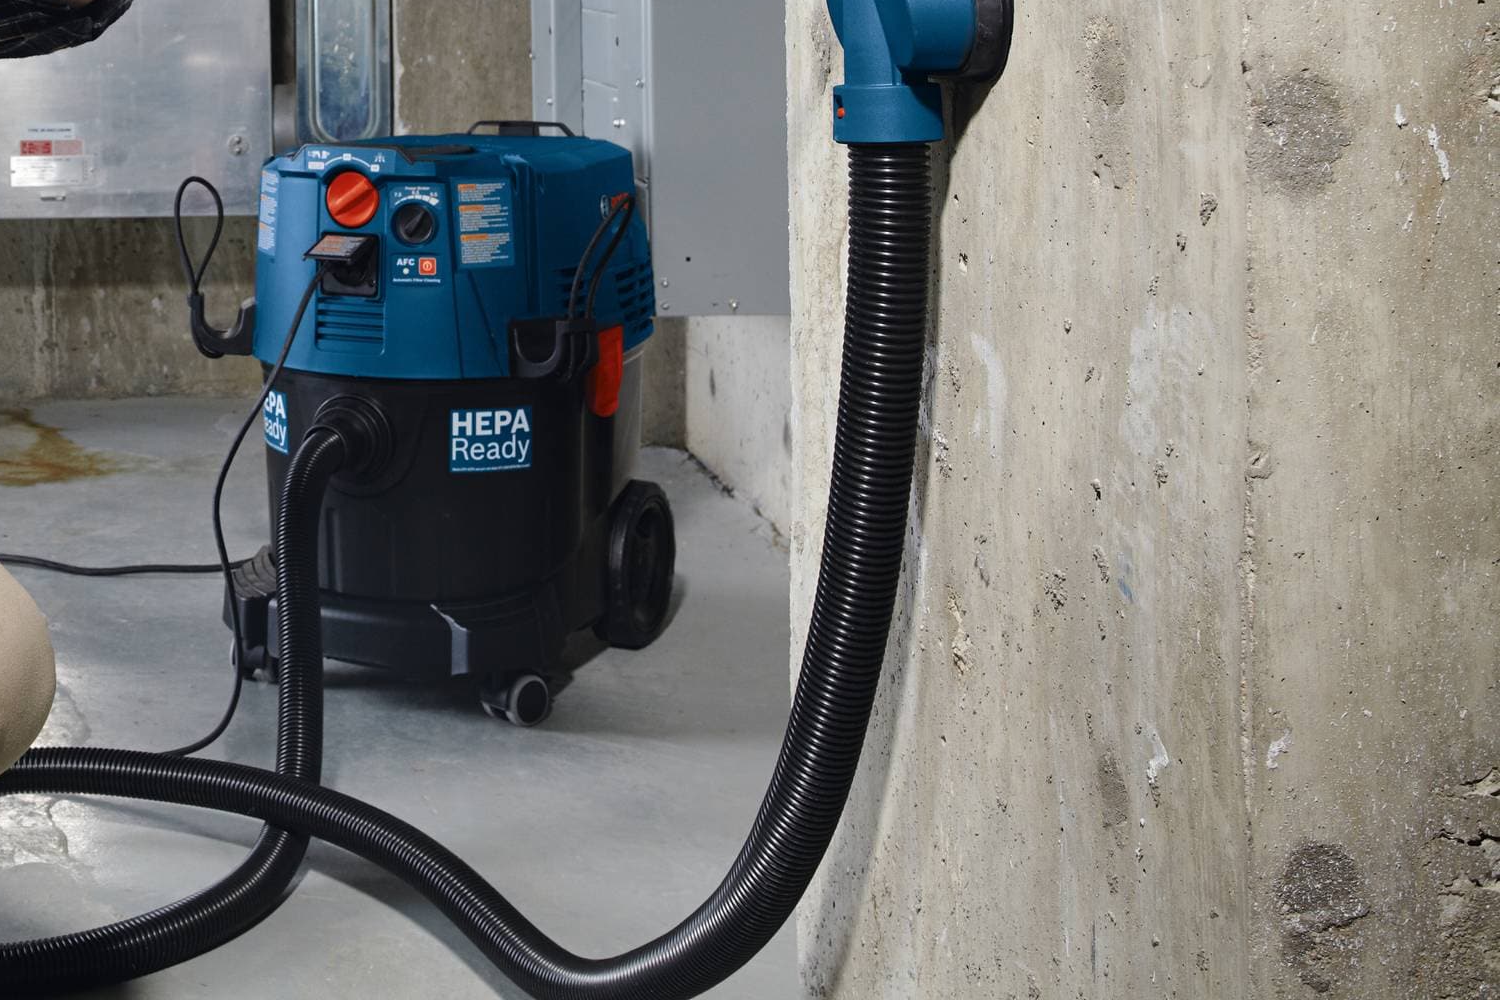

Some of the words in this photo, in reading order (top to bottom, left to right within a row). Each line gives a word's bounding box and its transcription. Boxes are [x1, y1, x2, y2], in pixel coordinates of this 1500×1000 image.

[396, 258, 415, 266] AFC
[452, 408, 530, 436] HEPA
[452, 434, 530, 463] Ready
